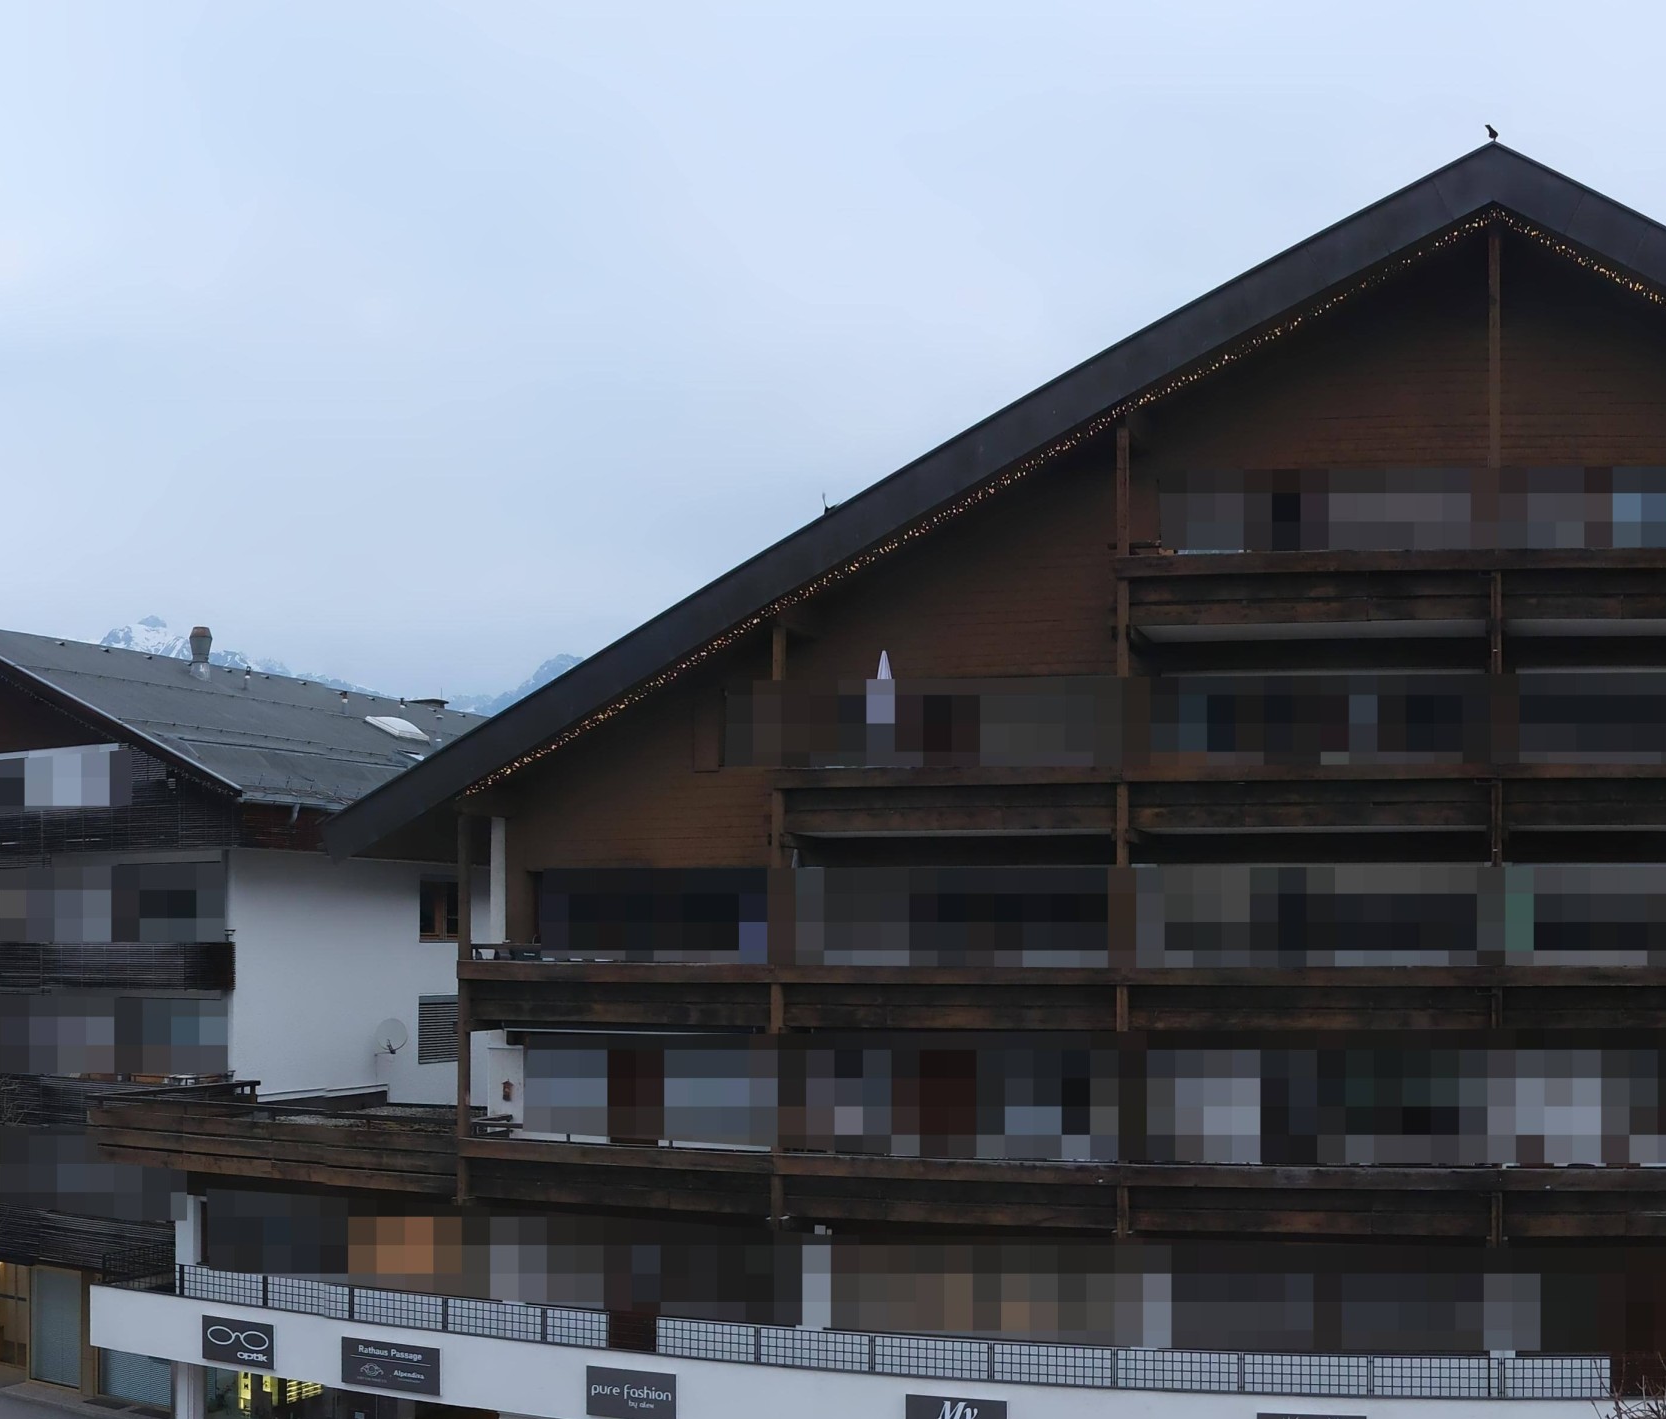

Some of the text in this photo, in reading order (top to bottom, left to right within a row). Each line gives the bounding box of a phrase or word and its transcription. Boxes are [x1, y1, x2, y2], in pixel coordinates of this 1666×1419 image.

[237, 1351, 268, 1363] optik
[358, 1345, 423, 1361] Rathaus Passage
[591, 1384, 672, 1402] pure fashion
[628, 1400, 638, 1409] by
